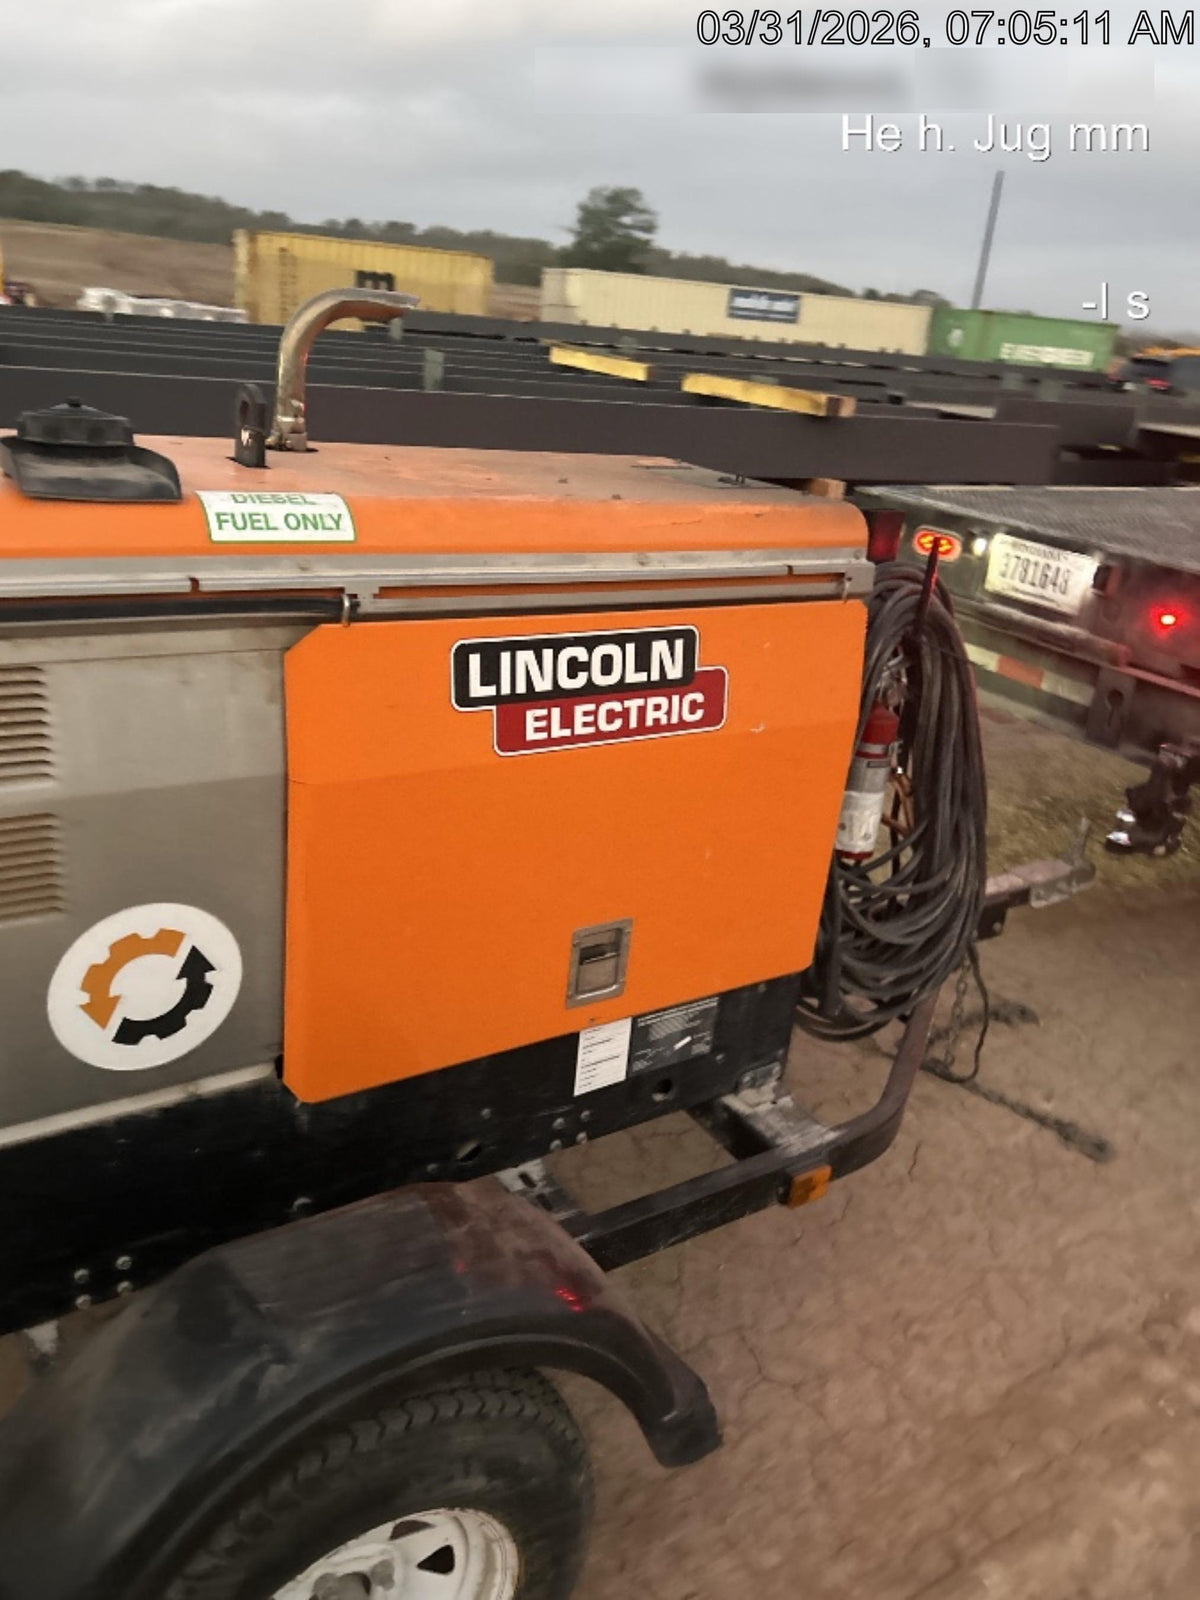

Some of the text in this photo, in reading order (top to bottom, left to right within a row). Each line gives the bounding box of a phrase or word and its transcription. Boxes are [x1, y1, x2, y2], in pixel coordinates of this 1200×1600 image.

[231, 493, 317, 505] DIESEL
[214, 511, 343, 531] FUEL ONLY
[467, 637, 685, 699] LINCOLN
[524, 691, 706, 742] ELECTRIC
